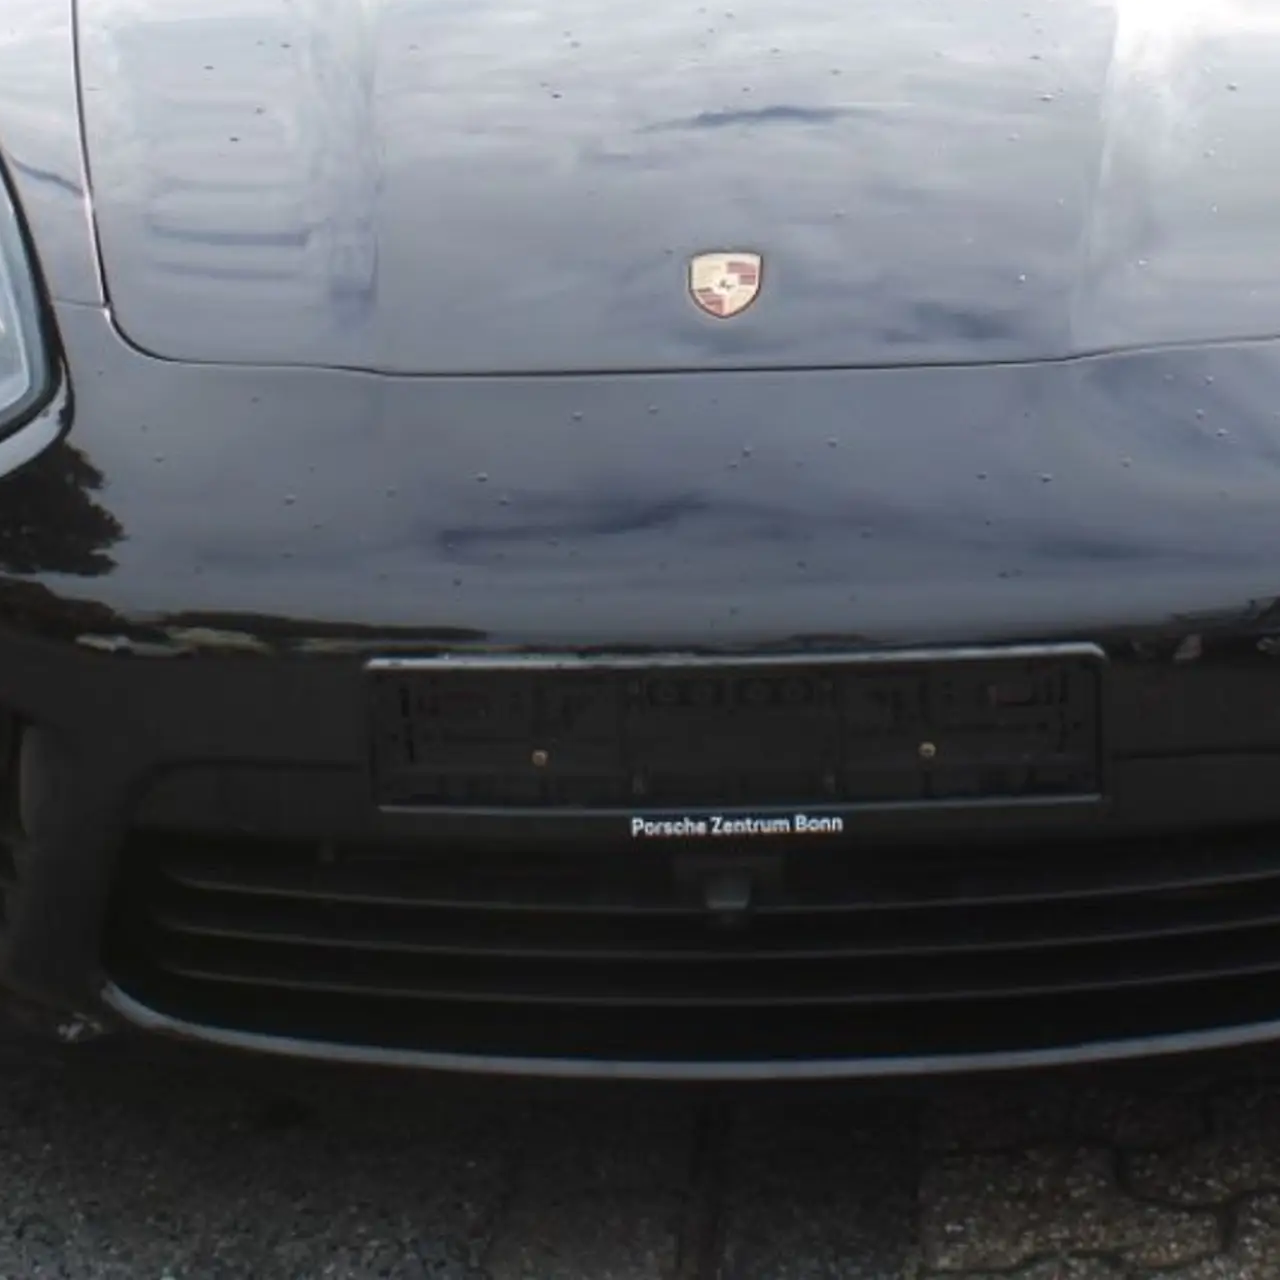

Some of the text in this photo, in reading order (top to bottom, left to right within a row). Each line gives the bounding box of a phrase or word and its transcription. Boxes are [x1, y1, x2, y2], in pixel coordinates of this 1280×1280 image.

[631, 813, 844, 838] Porsche Zentrum Bonn
